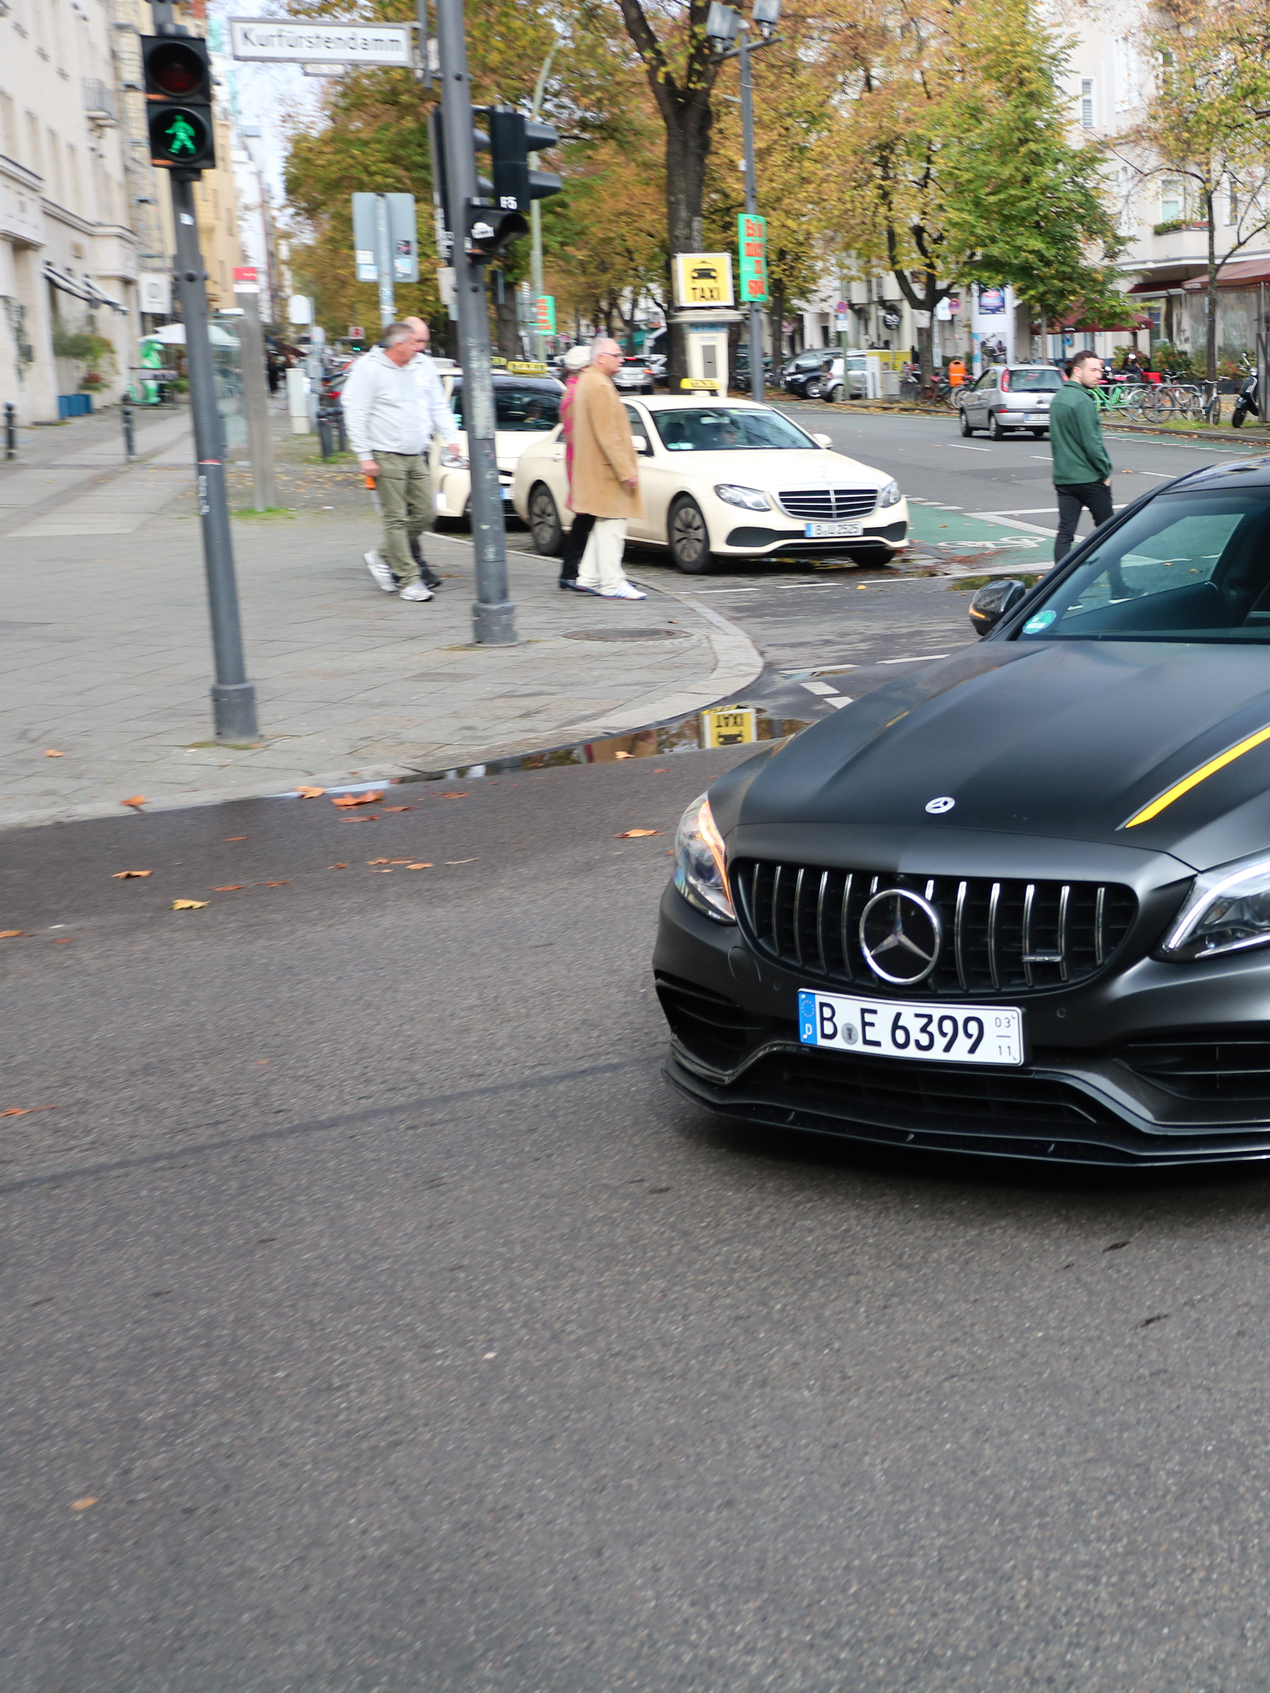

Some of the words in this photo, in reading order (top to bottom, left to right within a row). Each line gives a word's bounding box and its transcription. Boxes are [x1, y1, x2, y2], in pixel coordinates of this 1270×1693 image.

[240, 27, 403, 52] Kurfürstendamm
[691, 286, 721, 301] TAXI
[819, 1001, 838, 1040] B
[860, 1007, 882, 1047] E
[890, 1011, 985, 1054] 6399
[995, 1016, 1011, 1028] 03
[805, 1024, 813, 1035] D
[997, 1045, 1012, 1056] 11
